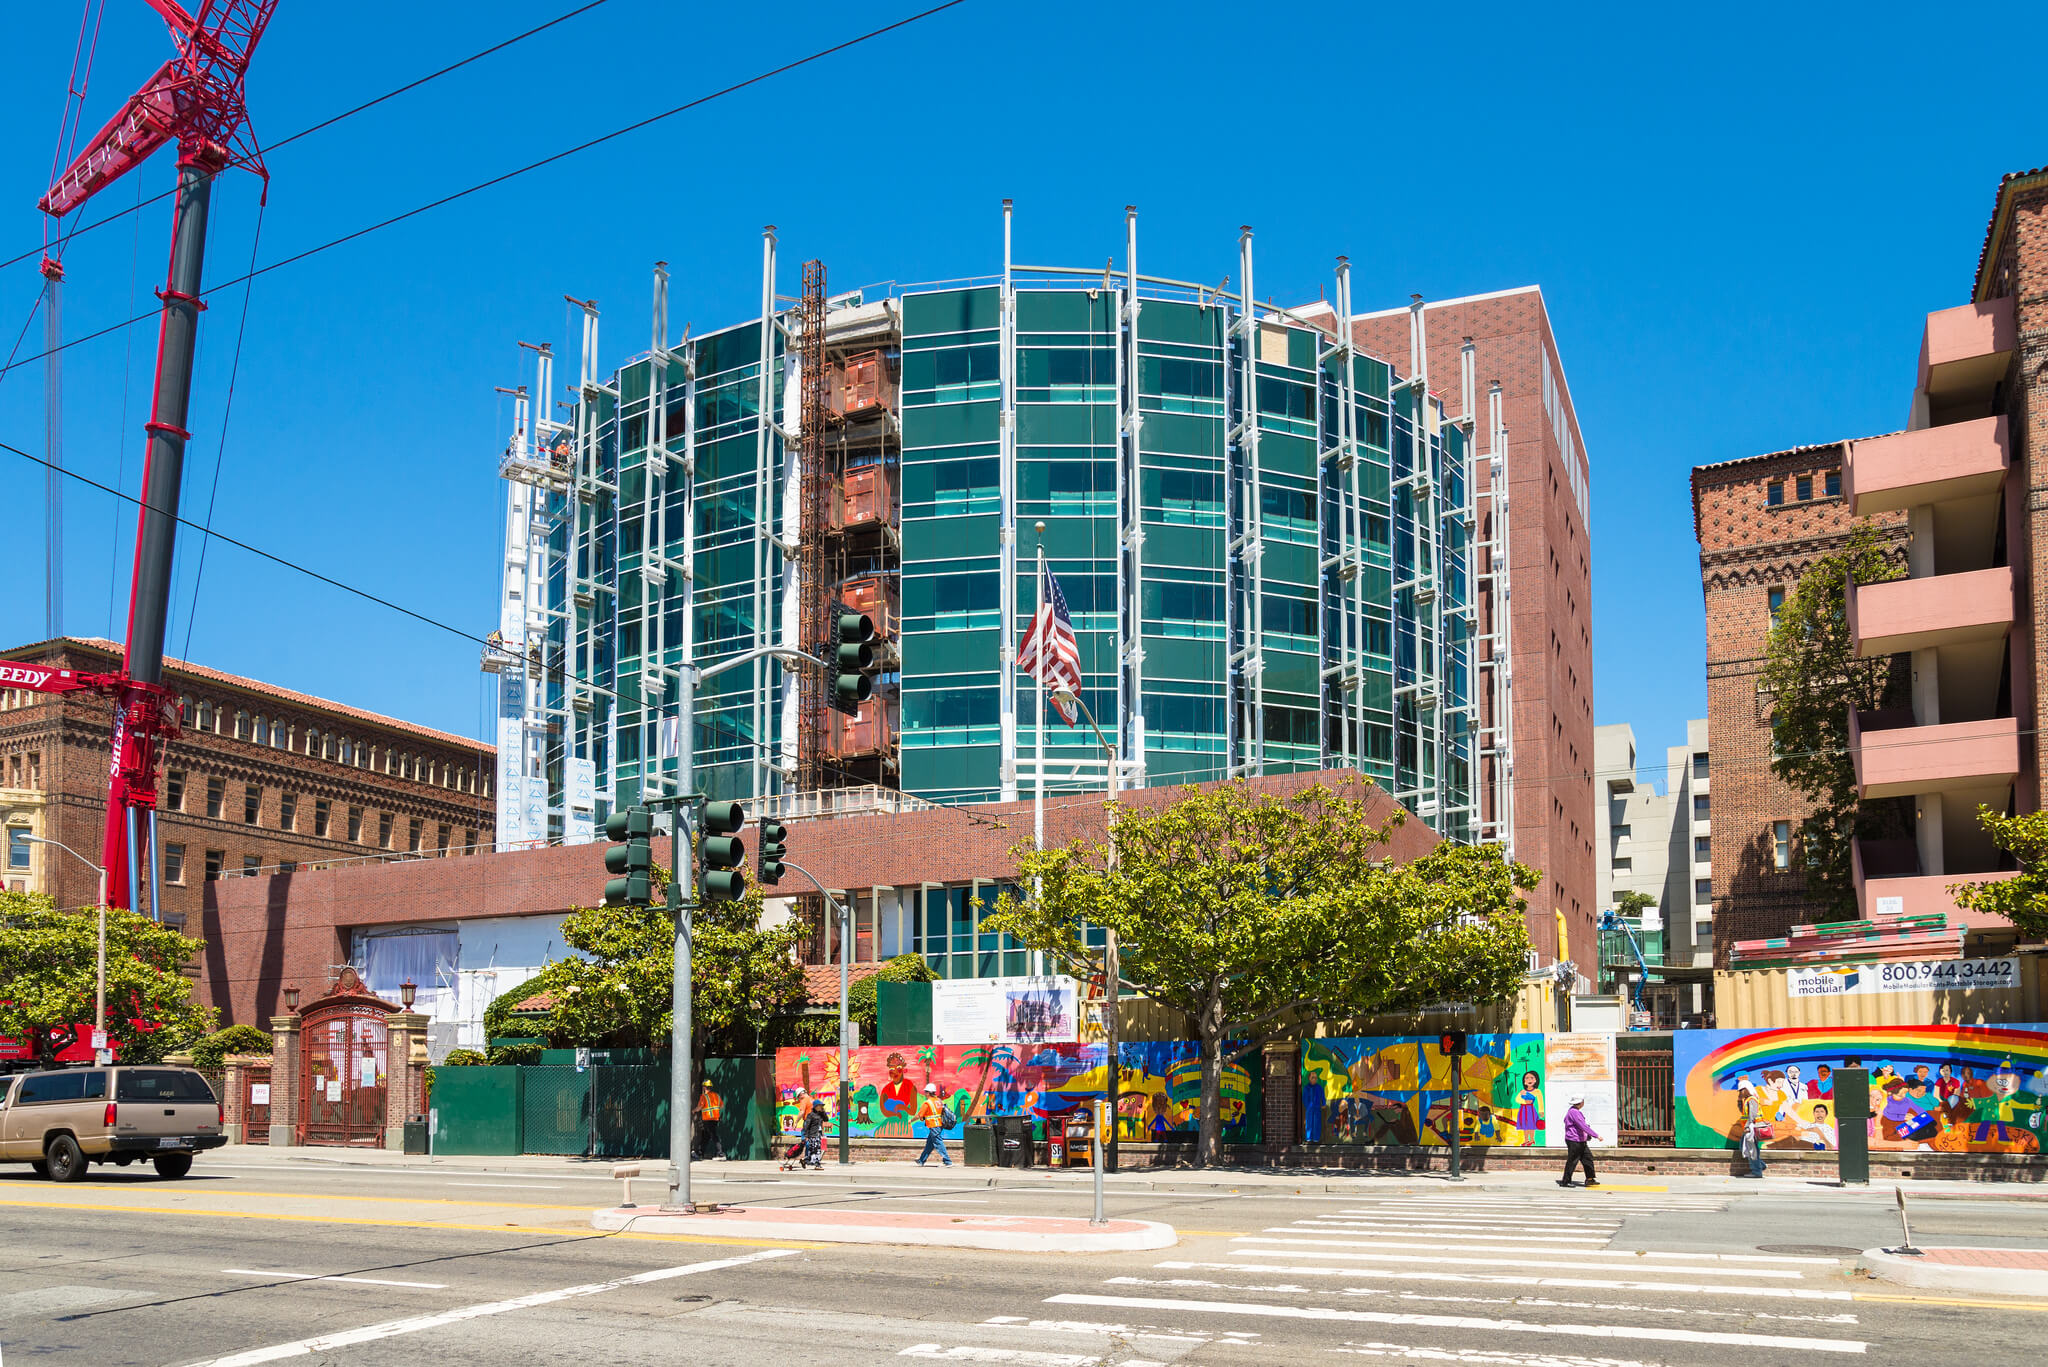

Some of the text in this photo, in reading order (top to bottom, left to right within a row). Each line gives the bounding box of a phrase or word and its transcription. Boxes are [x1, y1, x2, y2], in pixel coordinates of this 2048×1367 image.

[111, 703, 127, 777] SHEEDY
[1882, 961, 2012, 981] 800.944.3442
[1799, 976, 1834, 986] mobile
[1799, 984, 1843, 994] modular
